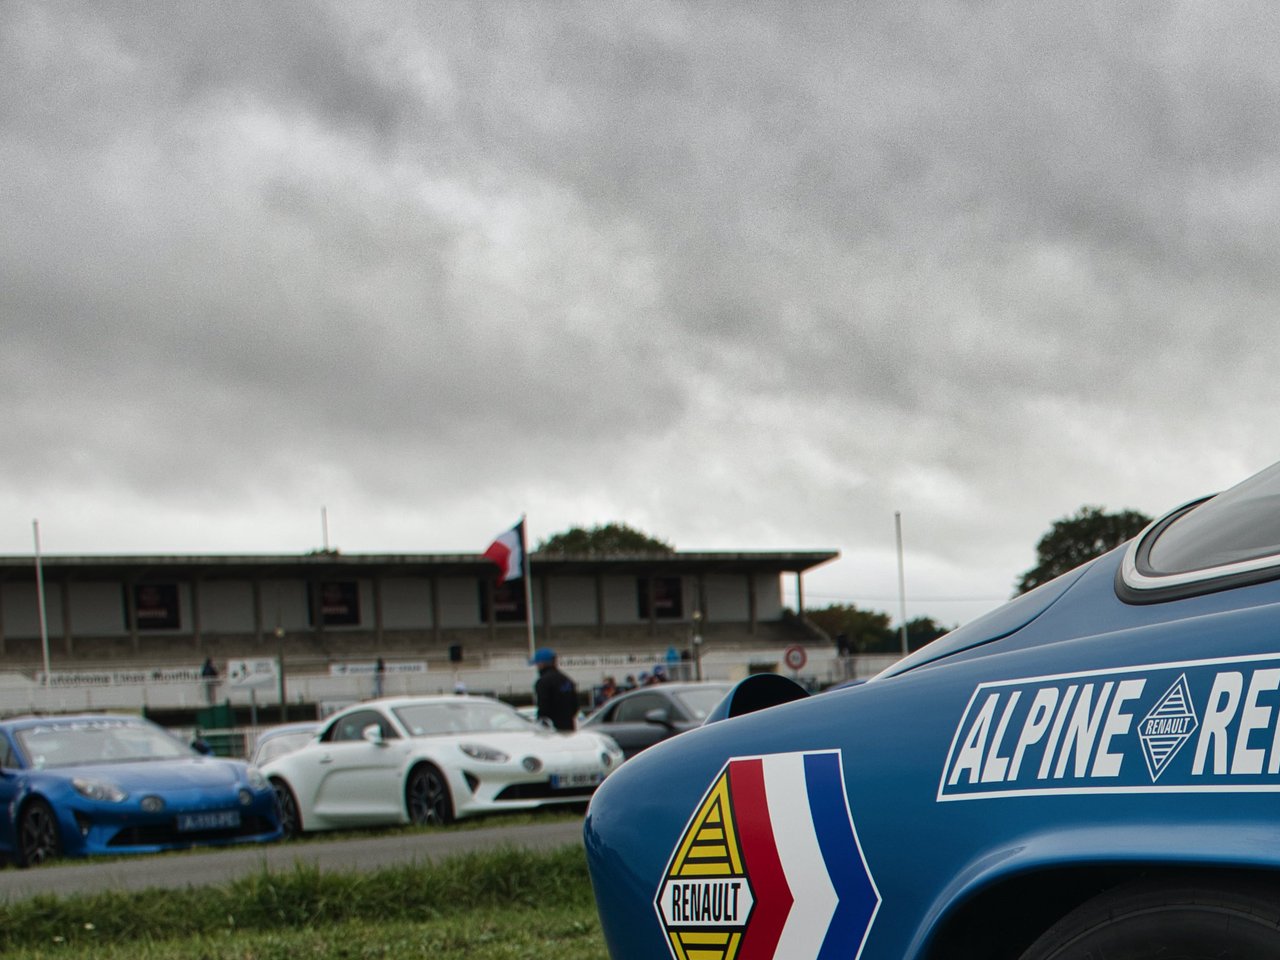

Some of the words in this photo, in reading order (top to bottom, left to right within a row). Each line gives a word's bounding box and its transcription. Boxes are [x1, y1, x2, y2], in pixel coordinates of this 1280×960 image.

[948, 678, 1147, 786] ALPINE
[1145, 718, 1190, 735] RENAULT
[672, 883, 741, 922] RENAULT
